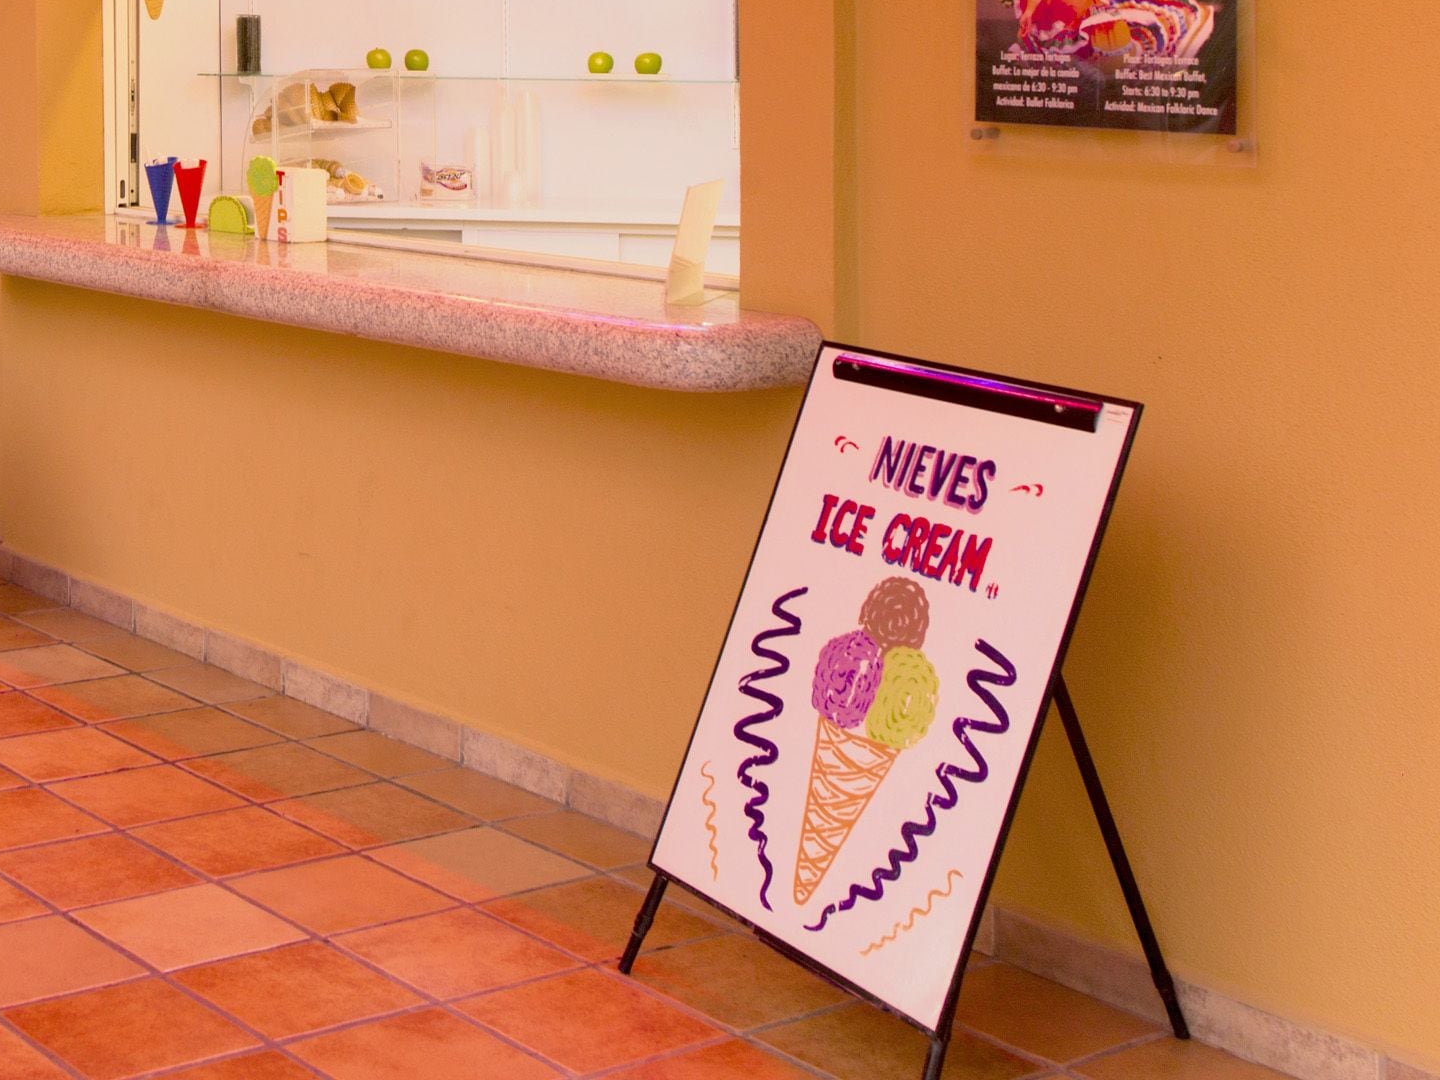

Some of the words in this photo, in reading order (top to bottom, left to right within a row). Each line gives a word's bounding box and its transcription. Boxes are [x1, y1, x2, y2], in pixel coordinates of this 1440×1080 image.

[1040, 66, 1049, 77] de
[1138, 69, 1153, 81] Best
[1022, 81, 1031, 92] de
[1067, 85, 1078, 96] pm
[1144, 86, 1160, 97] 6:30
[1169, 87, 1187, 98] 9:30
[1187, 90, 1200, 101] pm
[1196, 103, 1218, 117] Dance
[275, 170, 288, 244] TIPS
[868, 435, 997, 515] NIEVES
[810, 493, 876, 557] ICE
[881, 512, 994, 593] CREAM
